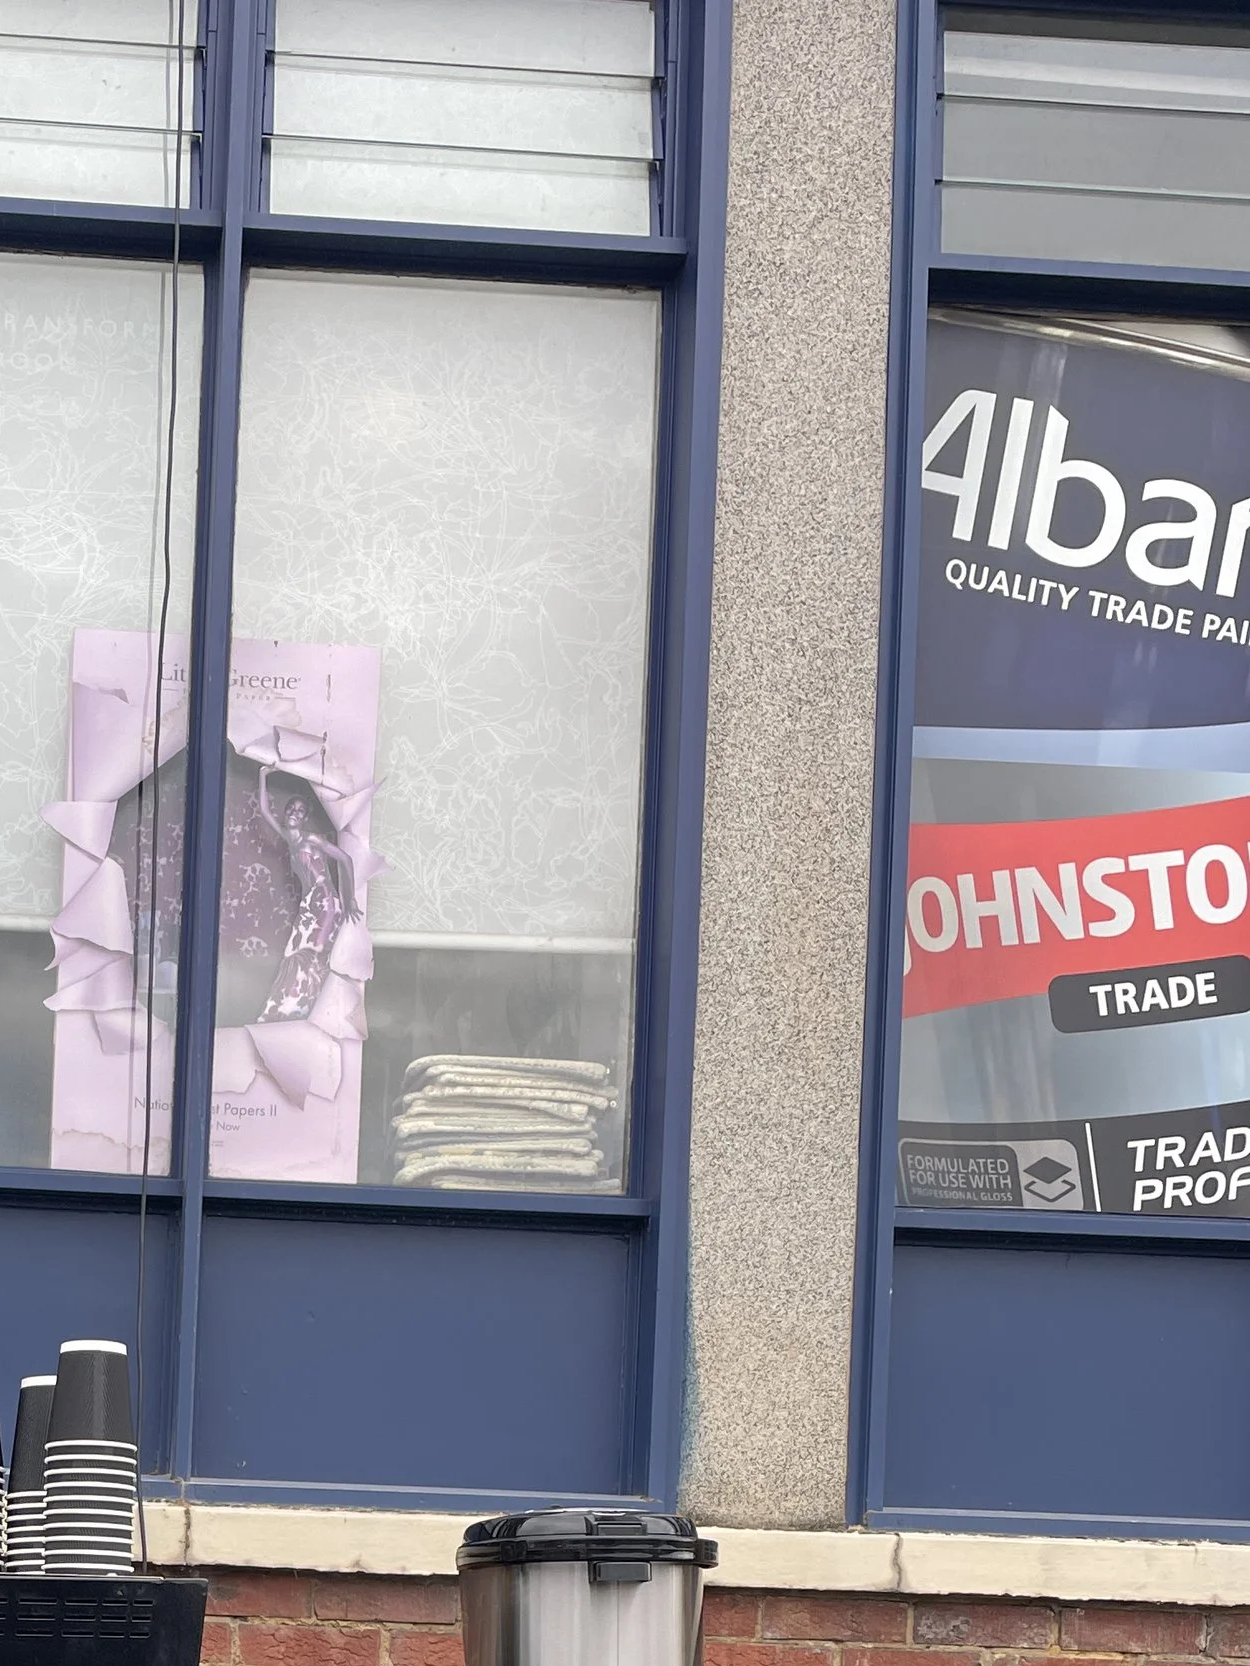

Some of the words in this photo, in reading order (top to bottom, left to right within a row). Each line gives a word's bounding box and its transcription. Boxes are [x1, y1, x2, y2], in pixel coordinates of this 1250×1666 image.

[945, 558, 1080, 611] QUALITY
[1088, 590, 1194, 636] TRADE
[160, 662, 187, 682] Lit
[903, 842, 1250, 976] OHNSTO
[1089, 971, 1218, 1017] TRADE
[134, 1096, 174, 1111] Natio
[224, 1103, 266, 1119] Papers
[216, 1121, 241, 1132] Now
[906, 1154, 1010, 1174] FORMULATED
[910, 1170, 937, 1186] FOR
[939, 1172, 967, 1188] USE
[969, 1174, 1012, 1189] WITH
[912, 1187, 978, 1201] PROFESSIONAL
[980, 1191, 1013, 1202] GLOSS
